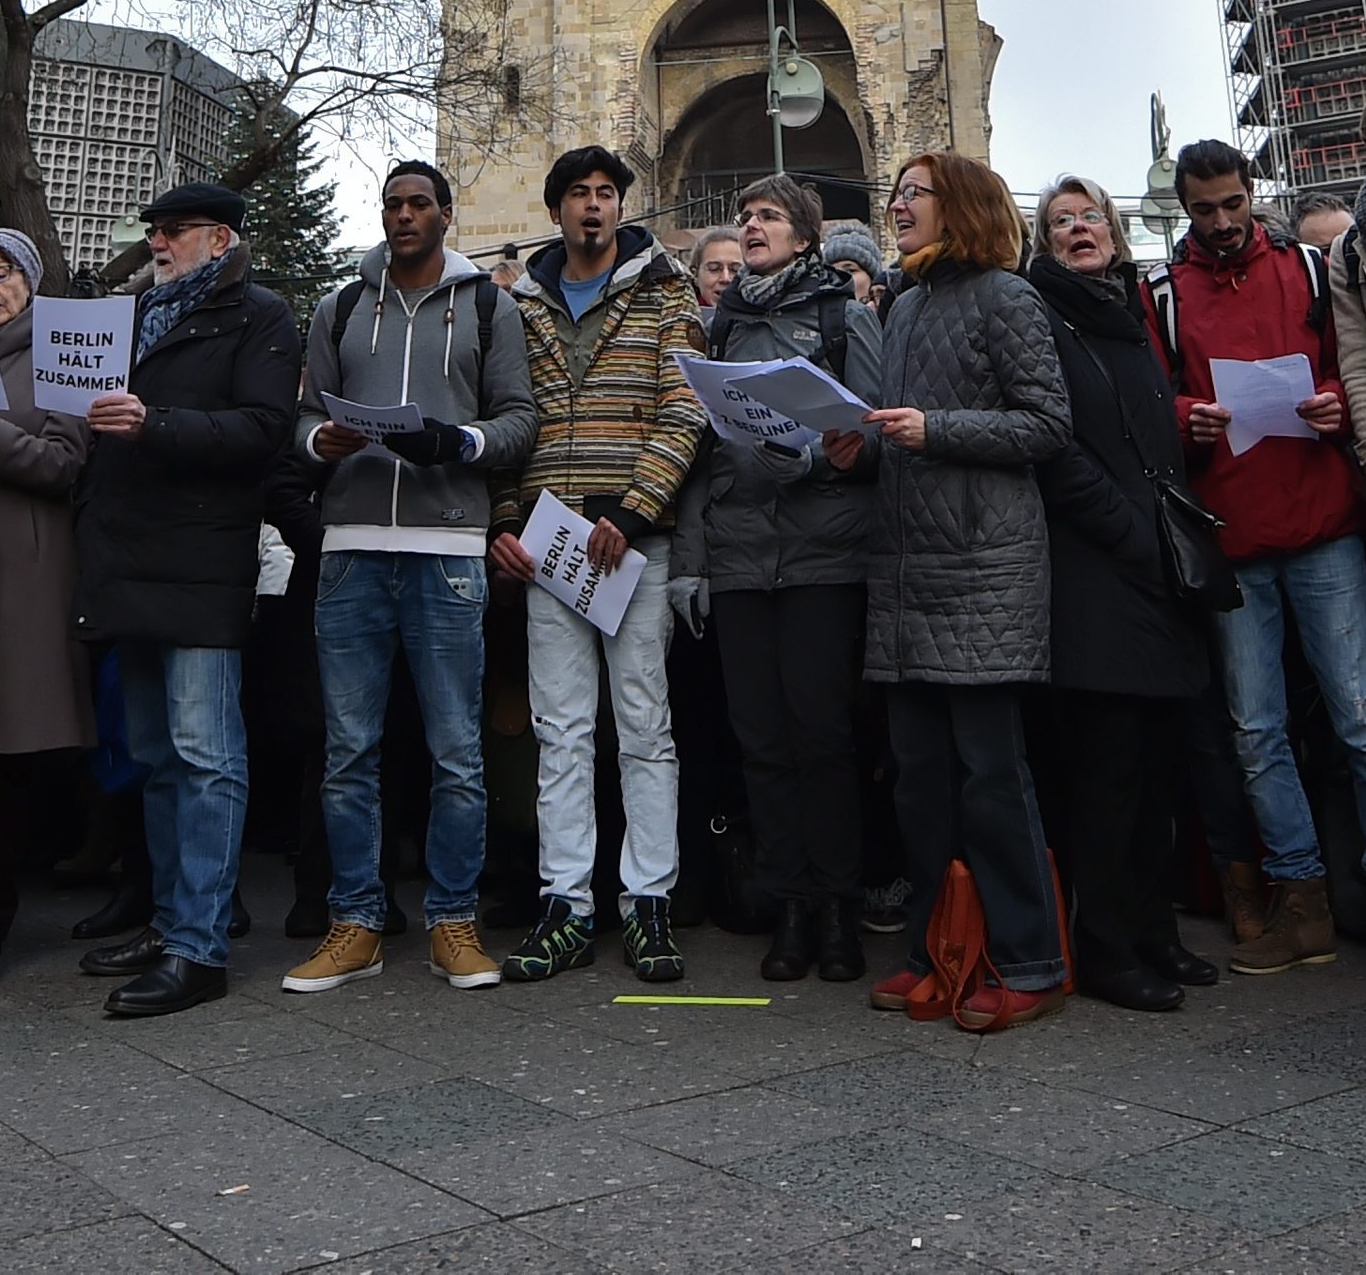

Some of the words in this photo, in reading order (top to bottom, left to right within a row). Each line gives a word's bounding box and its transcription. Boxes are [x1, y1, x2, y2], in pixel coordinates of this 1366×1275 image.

[50, 330, 114, 347] BERLIN
[58, 351, 104, 369] HÄLT
[35, 368, 126, 391] ZUSAMMEN
[722, 389, 749, 402] ICH
[745, 407, 773, 420] EIN
[344, 415, 372, 428] ICH
[376, 422, 405, 430] BIN
[541, 526, 571, 579] BERLIN
[562, 544, 588, 585] HÄLT
